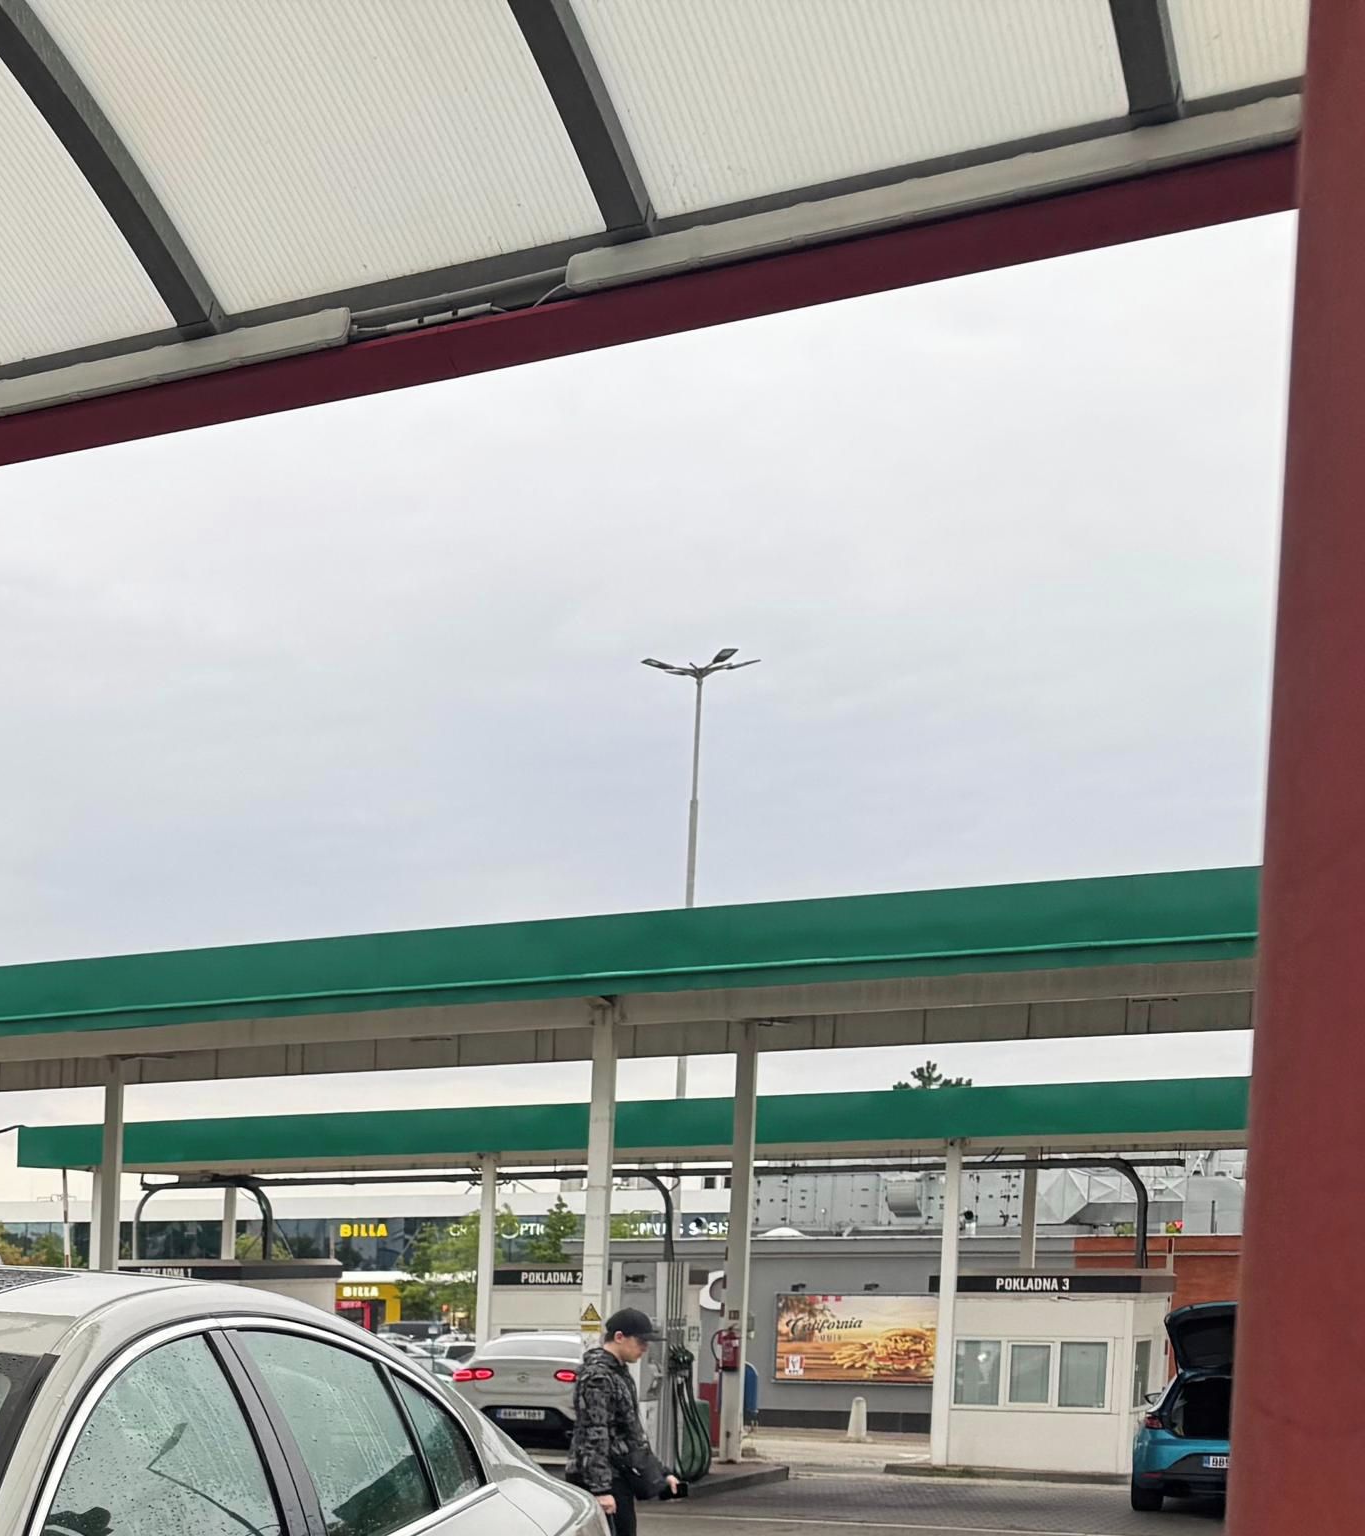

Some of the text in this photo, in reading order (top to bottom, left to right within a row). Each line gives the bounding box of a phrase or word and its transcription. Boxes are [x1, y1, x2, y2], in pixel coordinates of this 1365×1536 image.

[339, 1223, 388, 1238] BILLA
[688, 1221, 730, 1236] SSH
[520, 1271, 583, 1284] POKLADNA 2
[995, 1277, 1070, 1291] POKLADNA 3
[342, 1286, 379, 1297] BILLA
[785, 1316, 863, 1336] California
